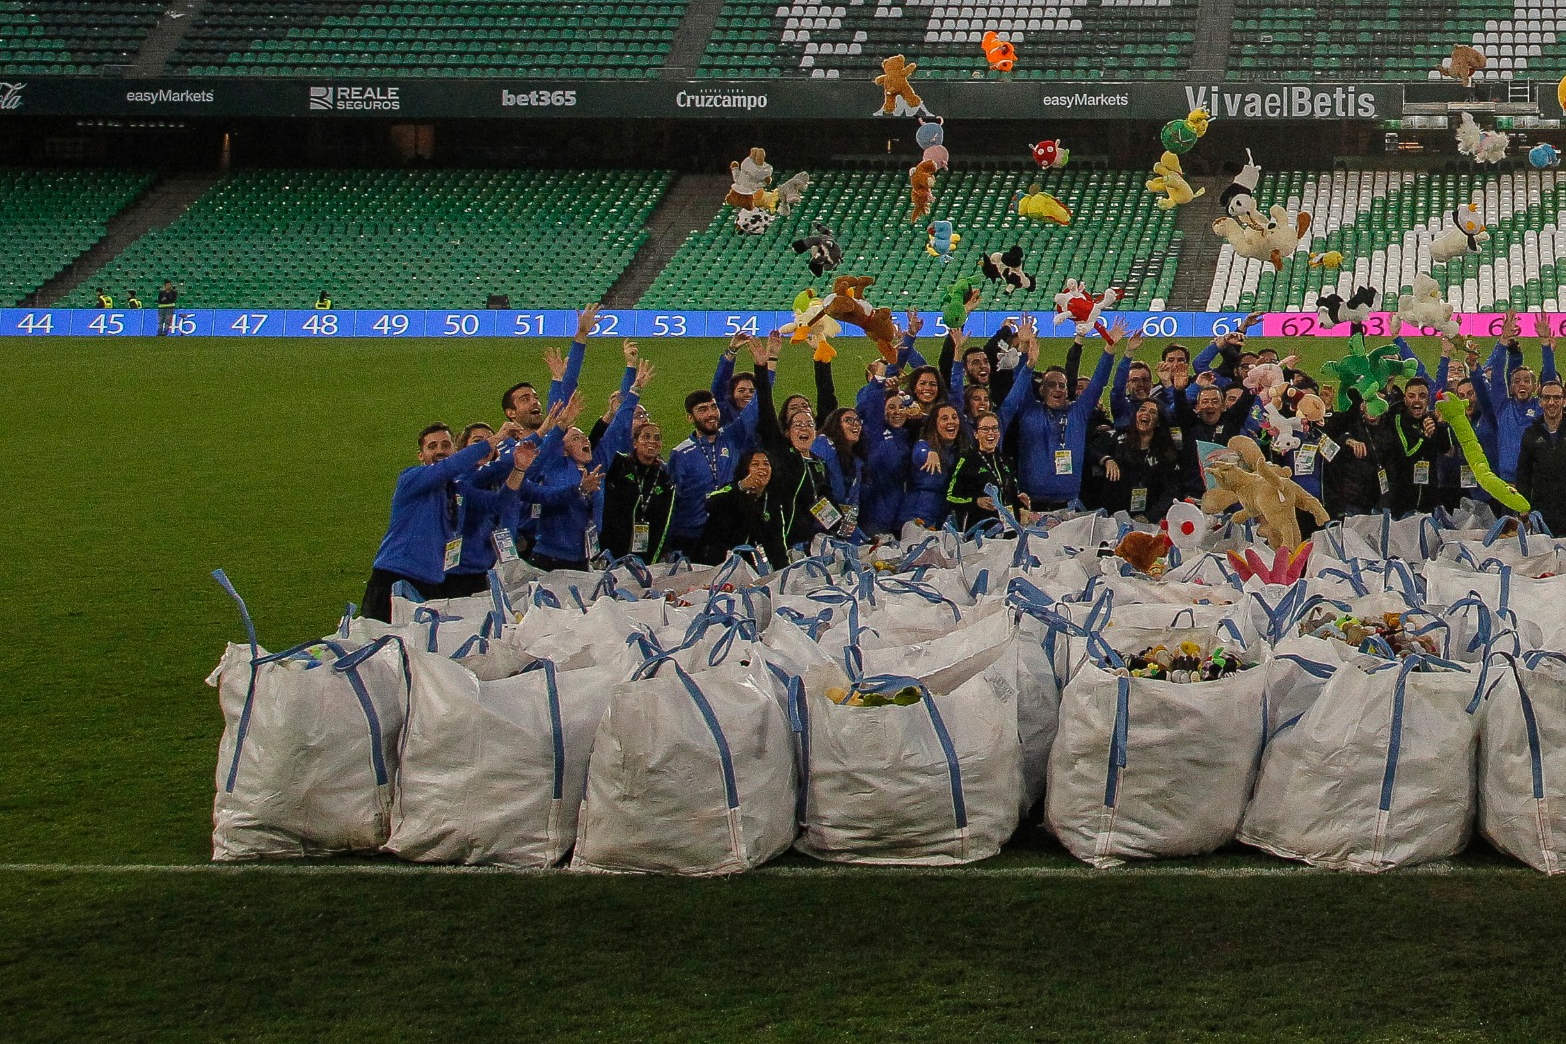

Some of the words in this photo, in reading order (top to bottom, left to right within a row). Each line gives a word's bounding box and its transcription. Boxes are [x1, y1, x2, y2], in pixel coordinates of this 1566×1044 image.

[126, 89, 214, 104] easyMarkets
[337, 87, 399, 100] REALE
[502, 90, 577, 106] bet365
[676, 90, 768, 111] Cruzcampo
[1043, 92, 1129, 108] easyMarkets
[337, 101, 400, 110] SEGUROS
[17, 313, 54, 334] 44
[88, 313, 125, 334] 45
[231, 314, 268, 334] 47
[302, 314, 338, 335] 48
[372, 314, 409, 335] 49
[443, 314, 480, 335] 50
[514, 314, 545, 335] 51
[652, 315, 687, 336] 53
[724, 315, 760, 336] 54
[1142, 317, 1177, 336] 60
[1212, 317, 1242, 336] 61
[1281, 318, 1315, 337] 62
